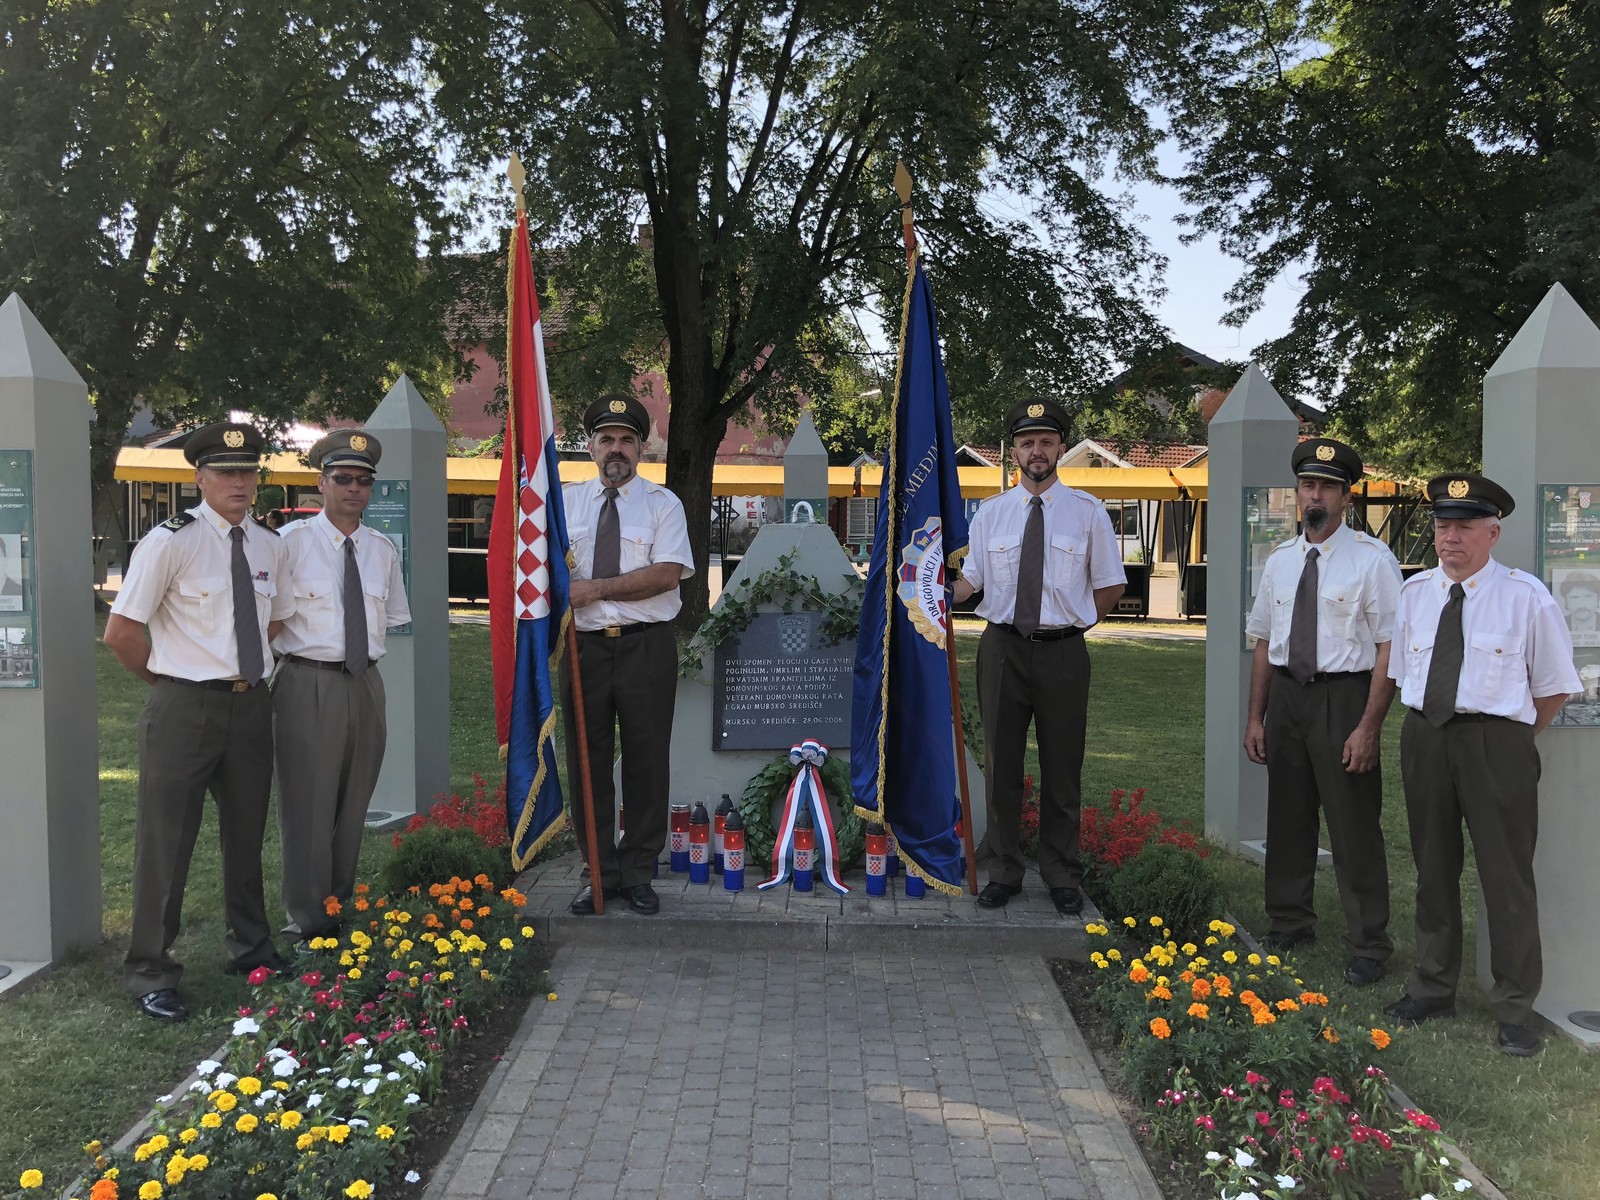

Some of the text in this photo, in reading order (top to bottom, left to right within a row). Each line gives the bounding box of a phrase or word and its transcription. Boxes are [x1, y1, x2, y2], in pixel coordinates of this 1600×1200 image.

[922, 560, 940, 618] DRAGOVOLJCI
[822, 692, 844, 700] RATA
[754, 702, 785, 710] MURSKO
